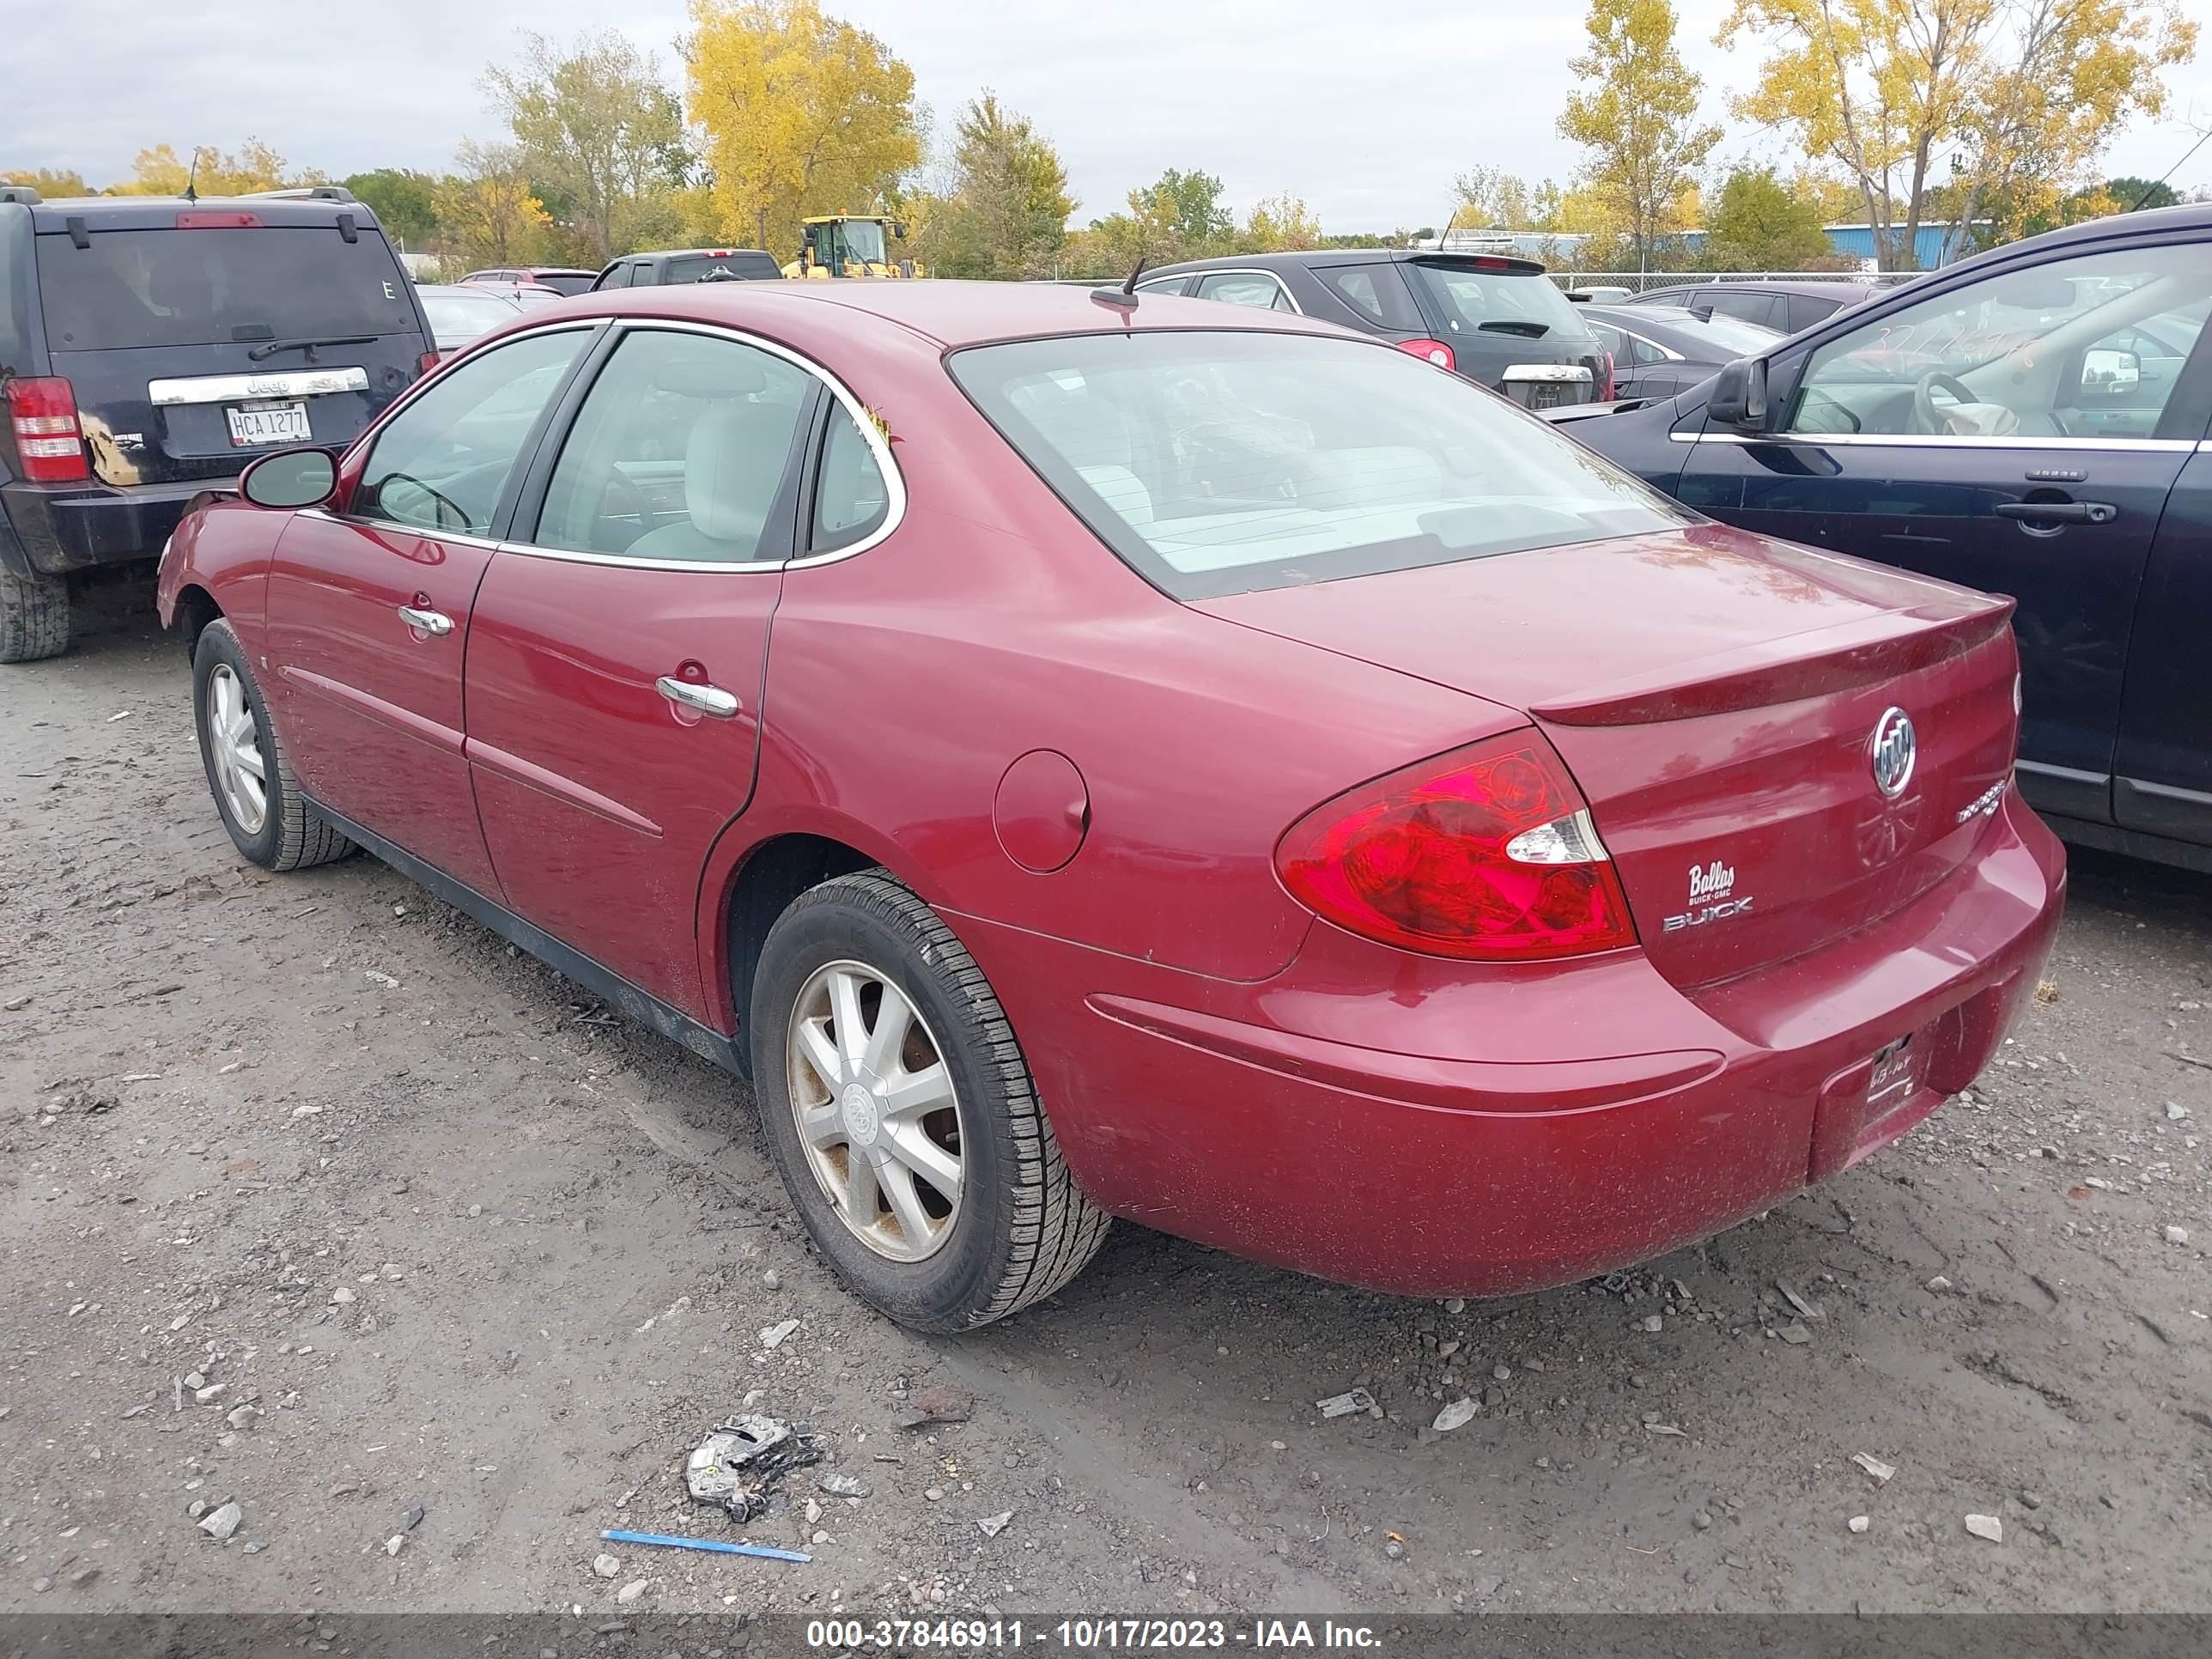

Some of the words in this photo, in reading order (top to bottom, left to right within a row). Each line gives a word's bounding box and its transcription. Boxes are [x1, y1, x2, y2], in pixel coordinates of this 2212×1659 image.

[382, 280, 396, 299] E
[247, 380, 289, 395] Jeep
[234, 413, 264, 436] HCA
[268, 412, 304, 434] 1277
[1688, 860, 1735, 897] Ballas
[1662, 896, 1753, 932] BUICK
